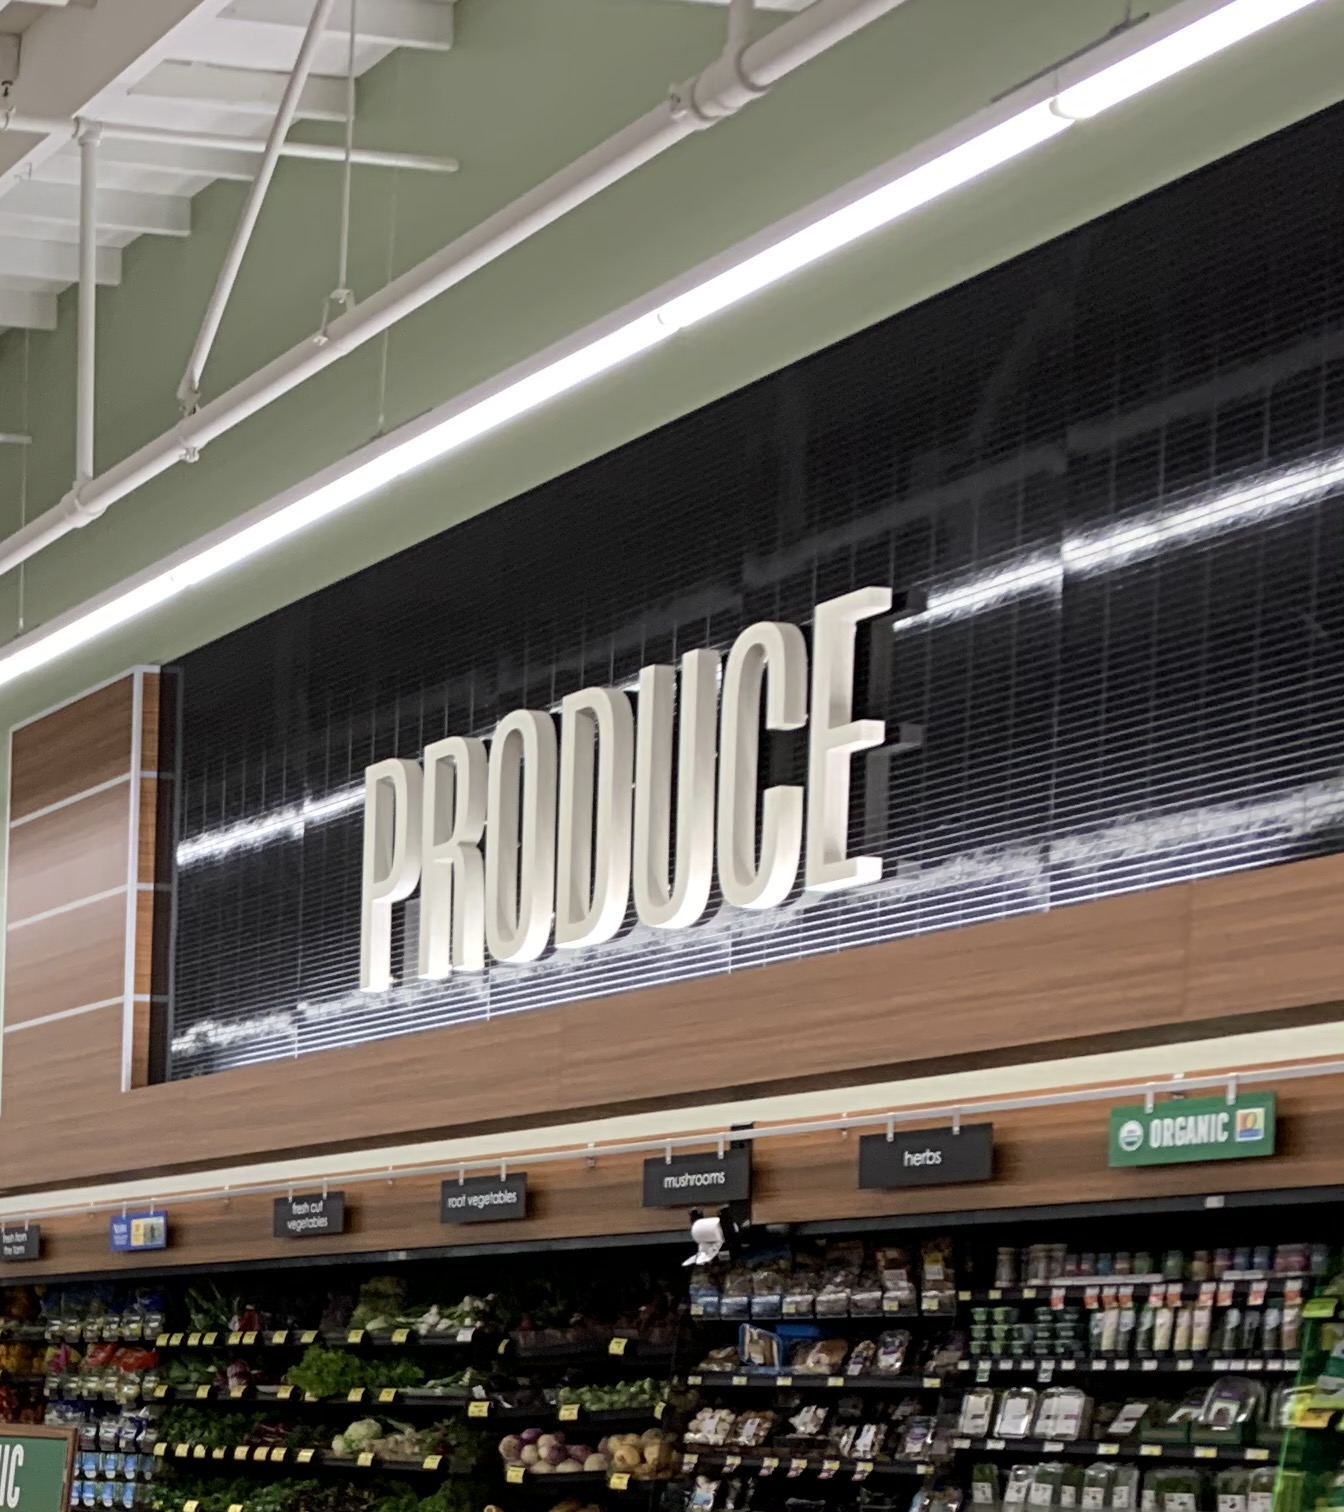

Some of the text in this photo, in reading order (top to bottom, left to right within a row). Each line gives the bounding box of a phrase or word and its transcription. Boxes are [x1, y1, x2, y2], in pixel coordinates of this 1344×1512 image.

[361, 586, 891, 993] PRODUCE
[1149, 1112, 1229, 1148] ORGANIC
[904, 1147, 942, 1167] herbs
[664, 1170, 725, 1189] mushrooms
[292, 1201, 324, 1215] fresh cut
[447, 1190, 518, 1209] root vegetables
[287, 1216, 328, 1232] vegetables
